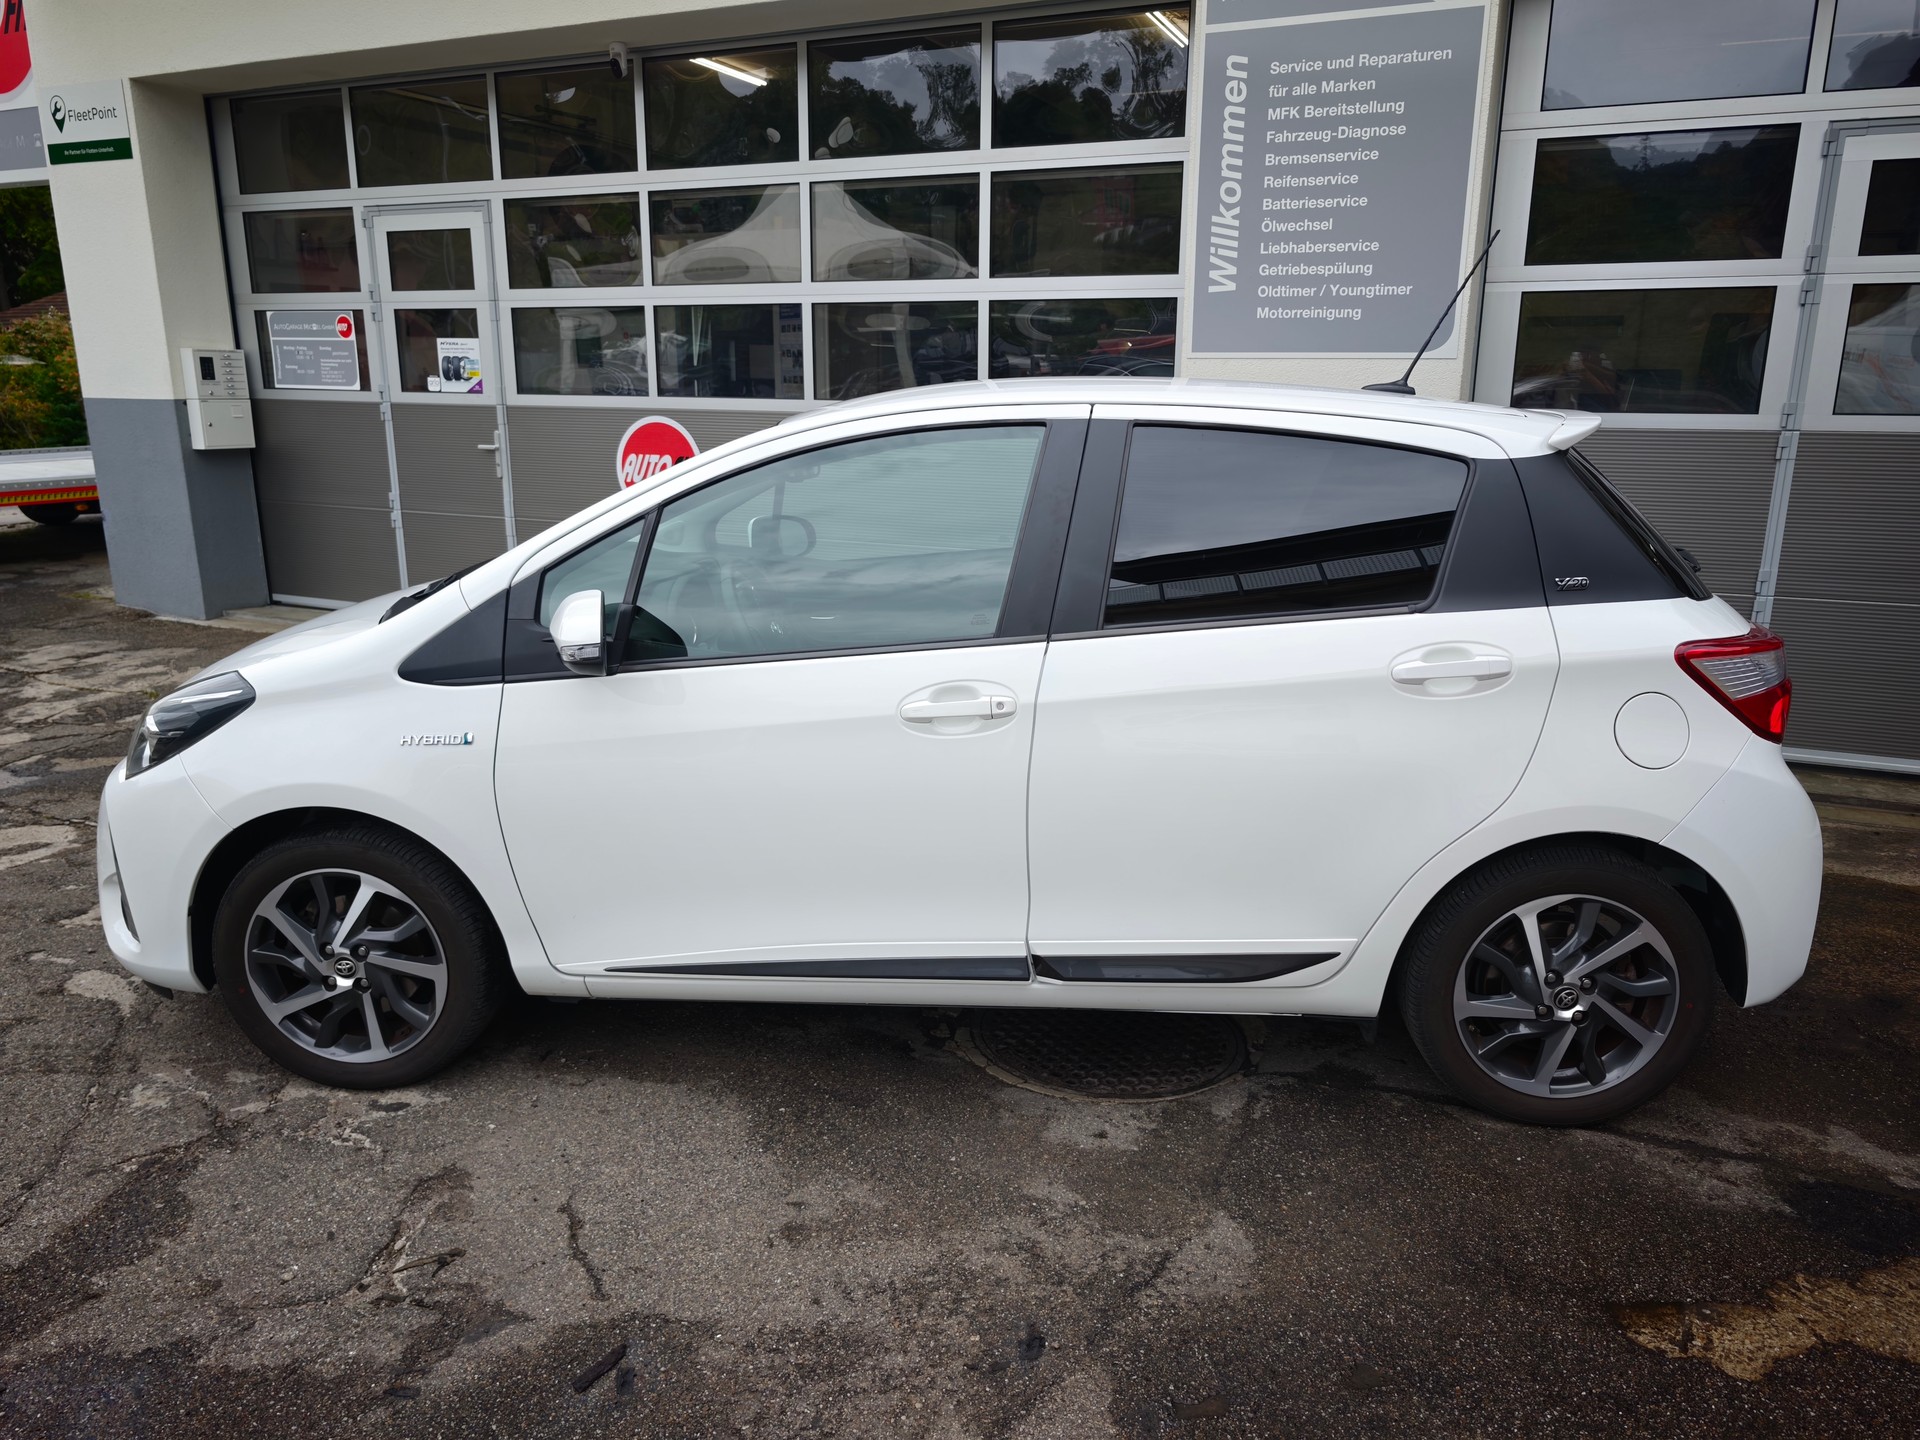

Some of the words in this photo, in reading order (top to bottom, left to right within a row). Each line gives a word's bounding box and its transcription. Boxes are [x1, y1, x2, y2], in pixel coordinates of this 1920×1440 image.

[1270, 59, 1323, 75] Service
[1327, 55, 1354, 70] und
[1358, 49, 1452, 68] Reparaturen
[1269, 85, 1288, 98] für
[1292, 82, 1317, 96] alle
[1321, 78, 1376, 94] Marken
[67, 107, 118, 122] FleetPoint
[1267, 106, 1300, 121] MFK
[1304, 100, 1405, 118] Bereitstellung
[1266, 125, 1407, 144] Fahrzeug-Diagnose
[1265, 148, 1379, 166] Bremsenservice
[1207, 54, 1249, 293] Willkommen
[1263, 172, 1359, 188] Reifenservice
[1262, 194, 1368, 211] Batterieservice
[1261, 217, 1333, 233] Ölwechsel
[1260, 239, 1380, 255] Liebhaberservice
[1258, 262, 1373, 277] Getriebespülung
[1257, 285, 1317, 298] Oldtimer
[1319, 284, 1327, 297] /
[1329, 283, 1413, 298] Youngtimer
[1256, 306, 1362, 321] Motorreinigung
[400, 734, 462, 746] HYBRID
